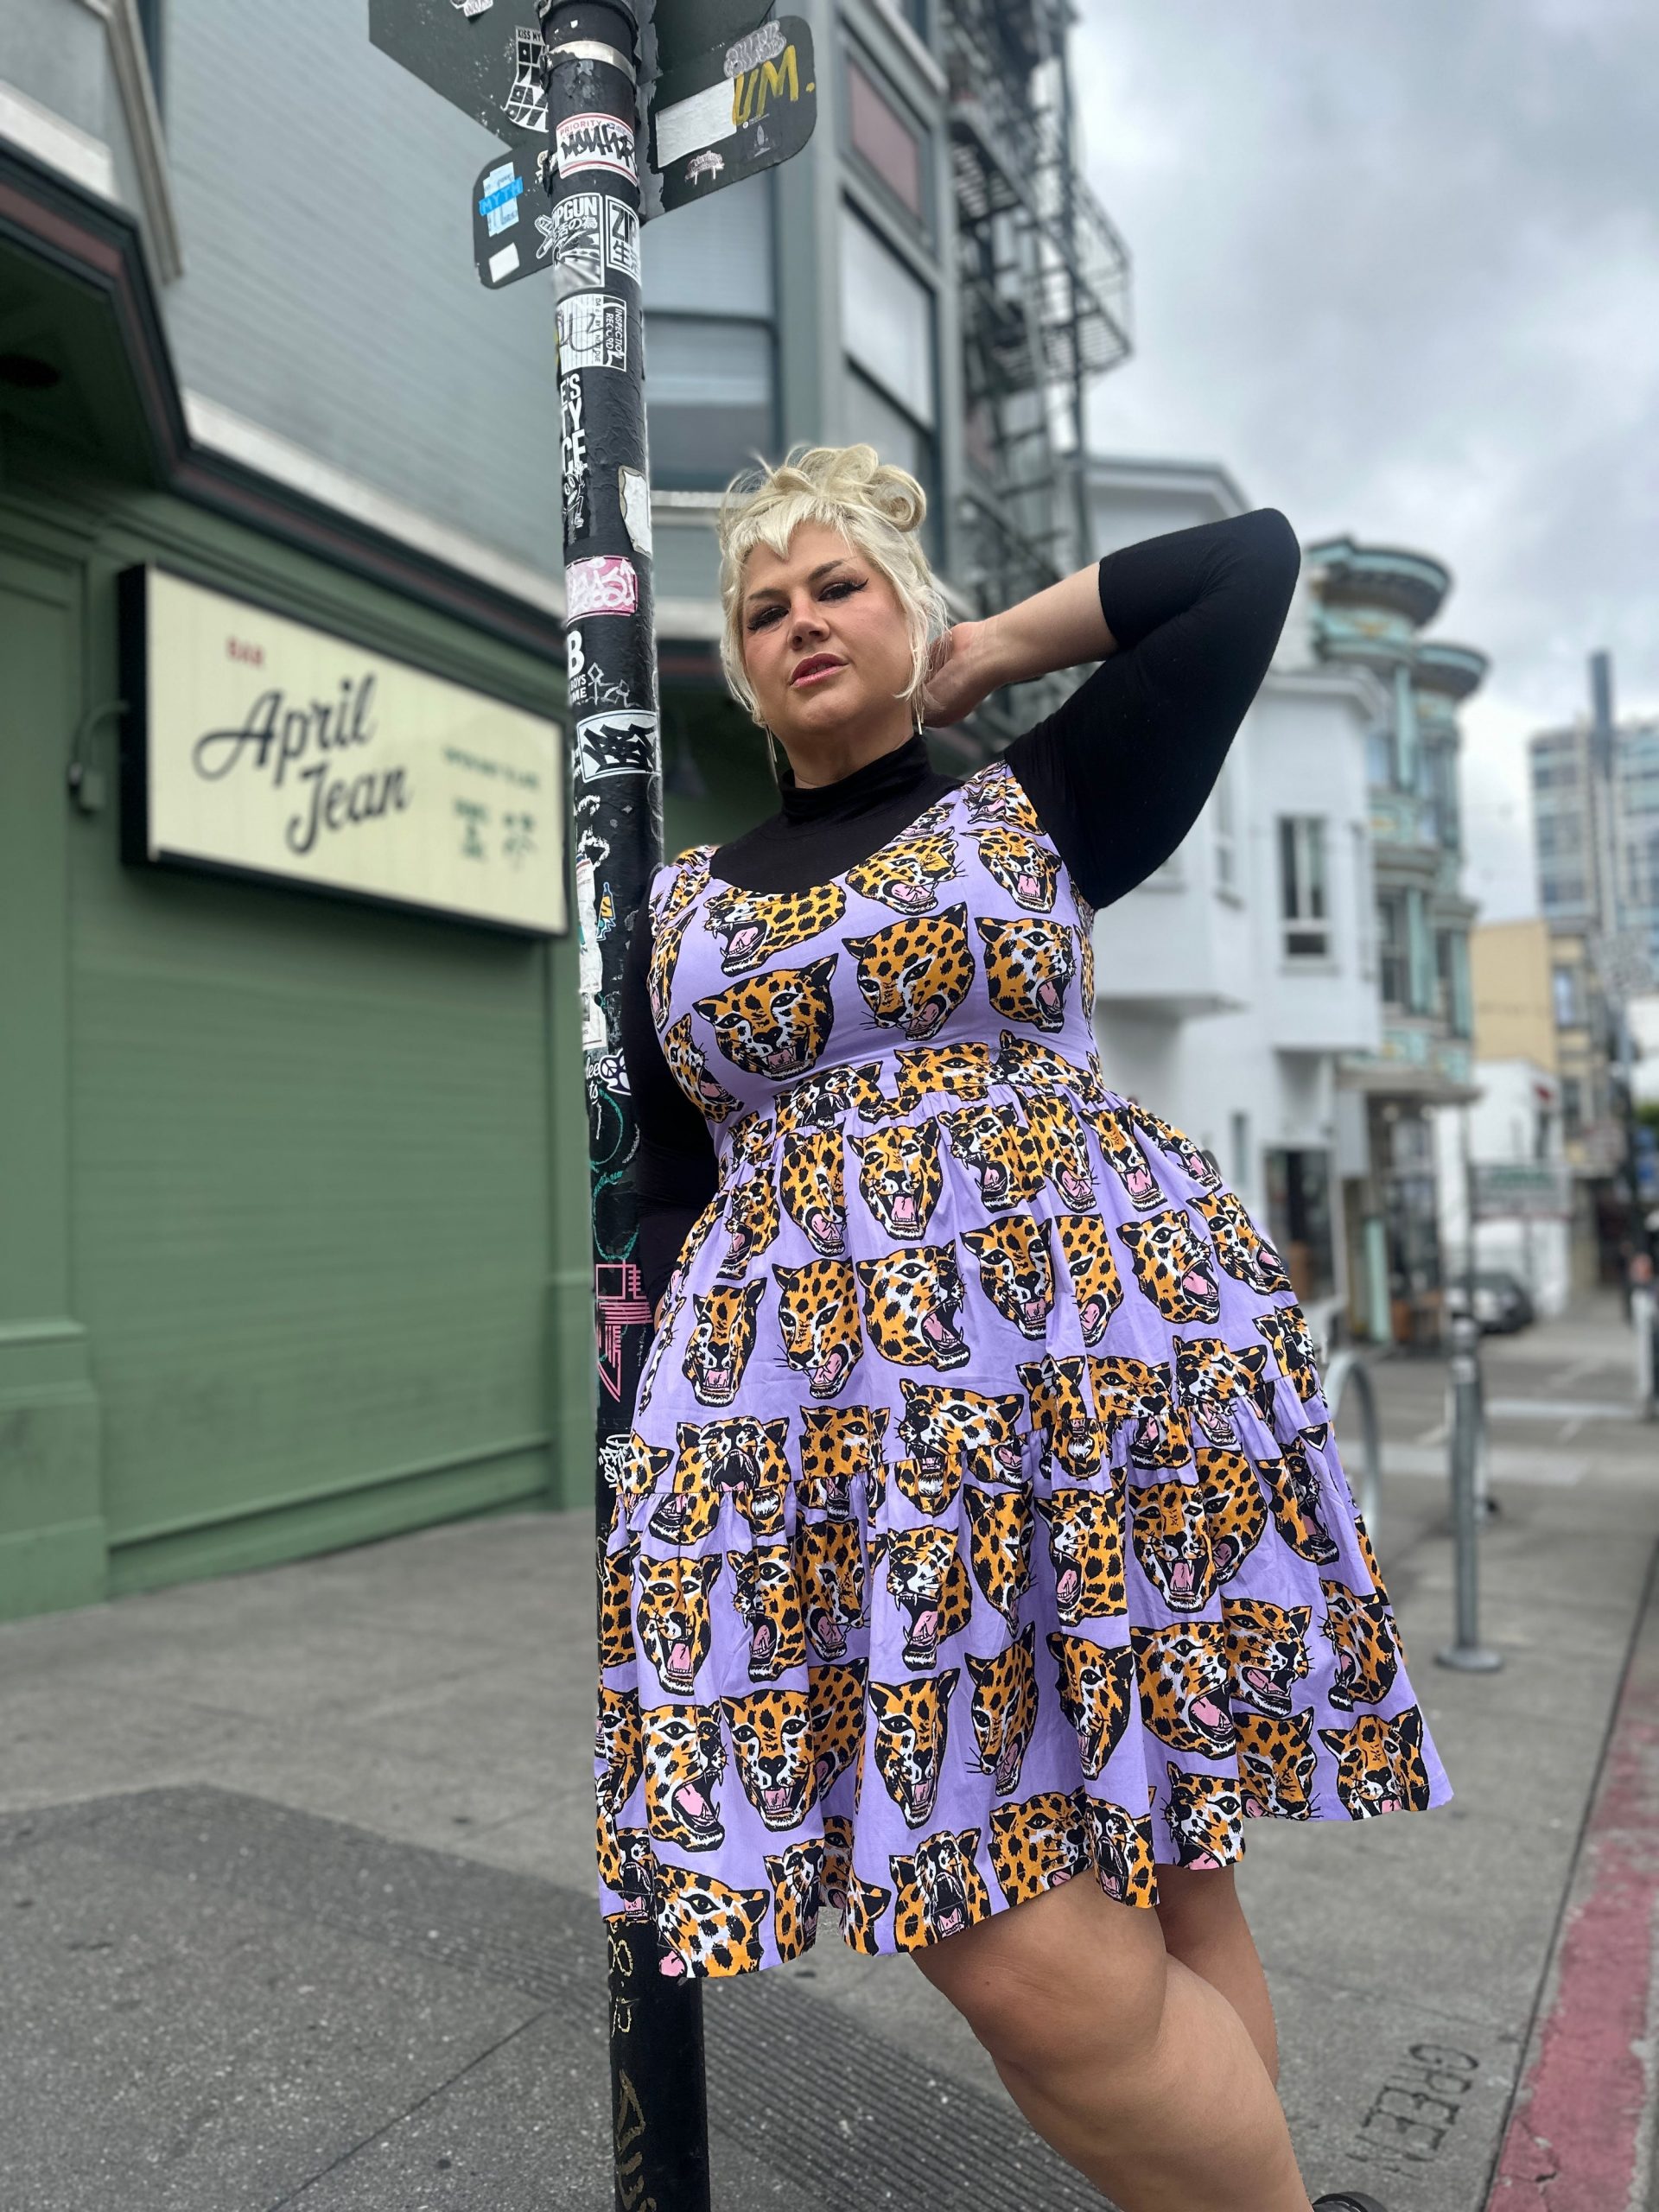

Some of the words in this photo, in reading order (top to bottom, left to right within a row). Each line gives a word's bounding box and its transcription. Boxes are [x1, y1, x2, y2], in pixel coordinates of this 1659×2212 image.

[518, 28, 531, 40] KISS
[532, 31, 541, 41] MY
[561, 119, 602, 136] PRIORITY
[479, 176, 522, 215] MYTH
[606, 313, 614, 349] RECORD
[614, 308, 623, 359] INSPECTION
[226, 636, 266, 667] BAR
[192, 672, 378, 789] April
[286, 765, 412, 854] Jean
